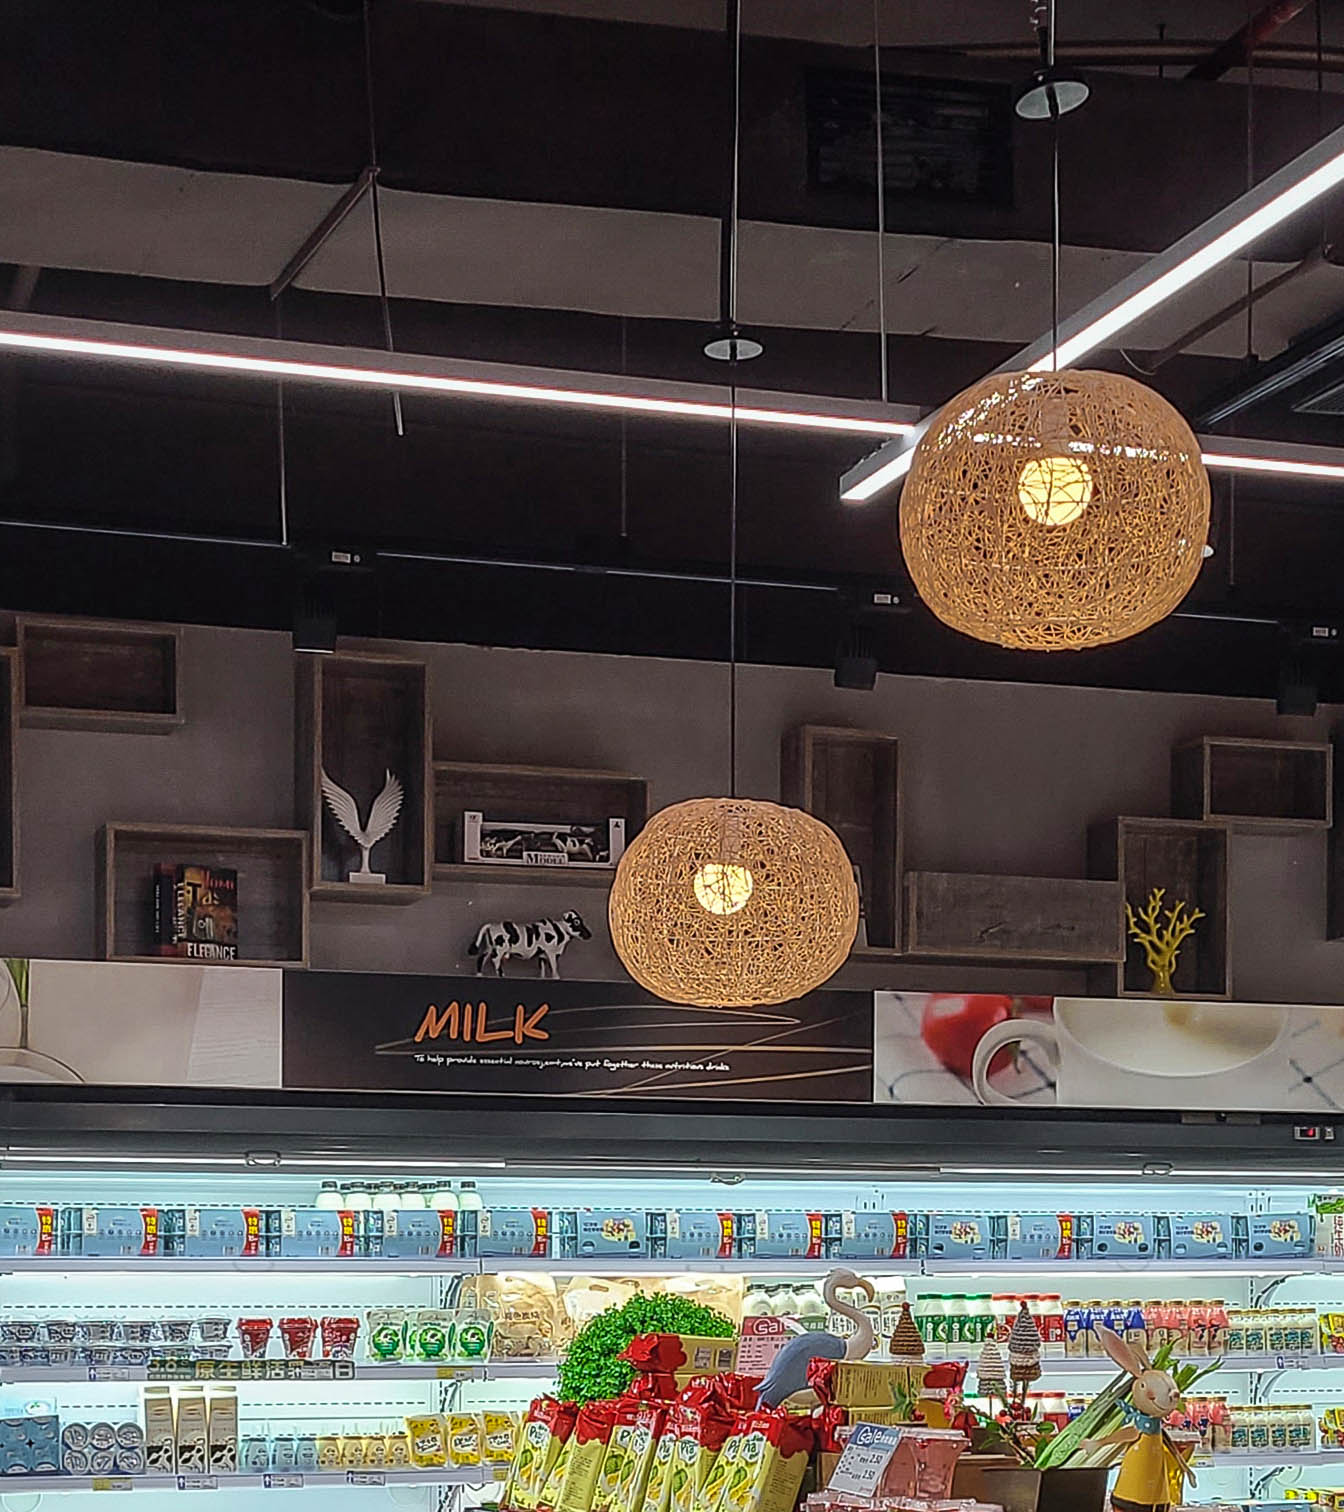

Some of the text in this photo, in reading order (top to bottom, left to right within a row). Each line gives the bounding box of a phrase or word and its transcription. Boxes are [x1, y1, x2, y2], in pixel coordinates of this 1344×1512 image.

[413, 1000, 551, 1046] MILK
[427, 1055, 444, 1066] help
[446, 1056, 477, 1066] provide
[585, 1060, 601, 1070] put
